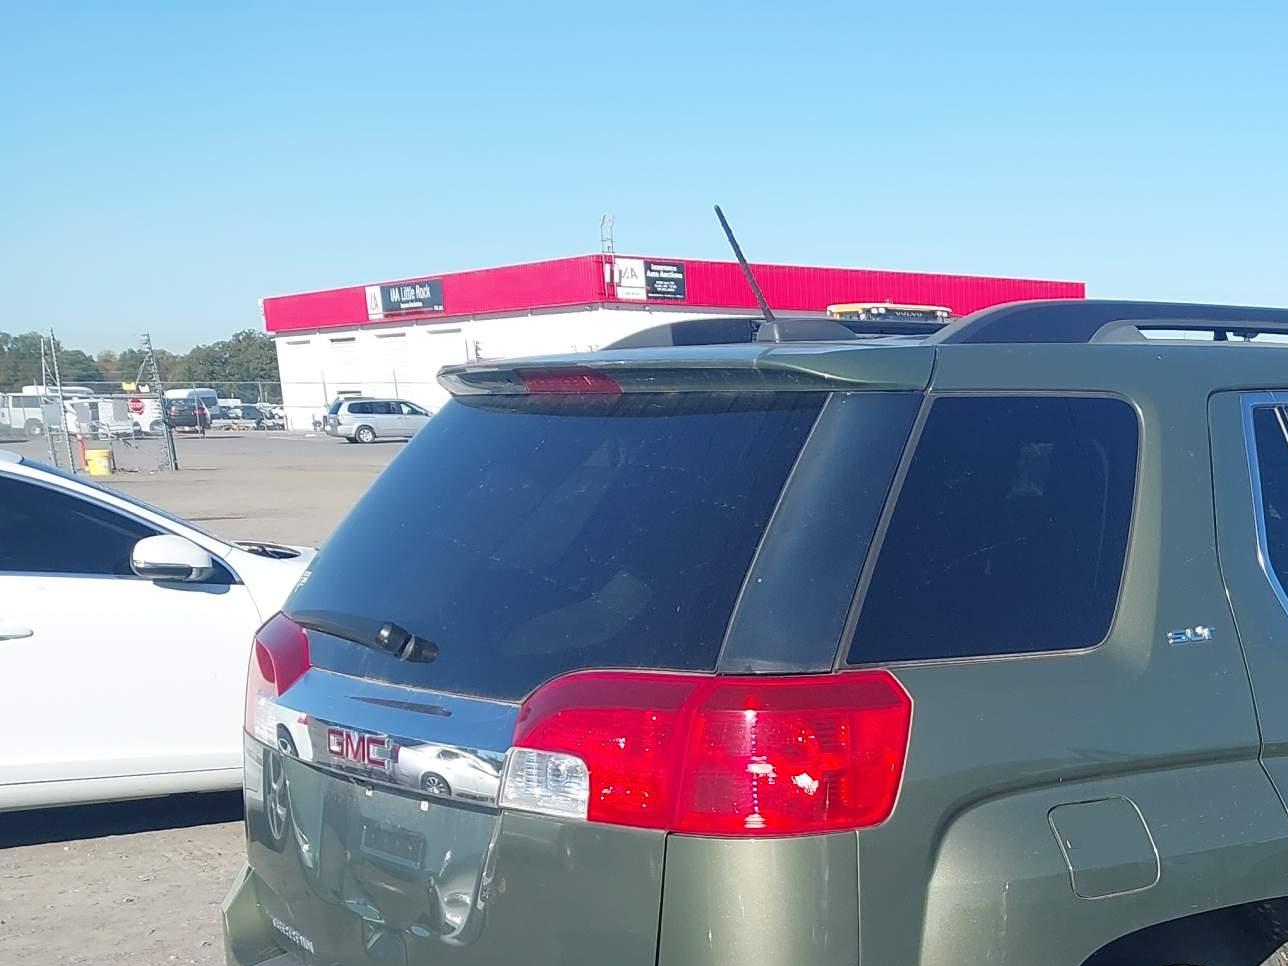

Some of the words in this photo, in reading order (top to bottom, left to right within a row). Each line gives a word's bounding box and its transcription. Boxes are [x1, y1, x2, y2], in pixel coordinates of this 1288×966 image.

[400, 286, 415, 301] Little
[415, 284, 431, 299] Rock
[327, 726, 392, 773] GMC
